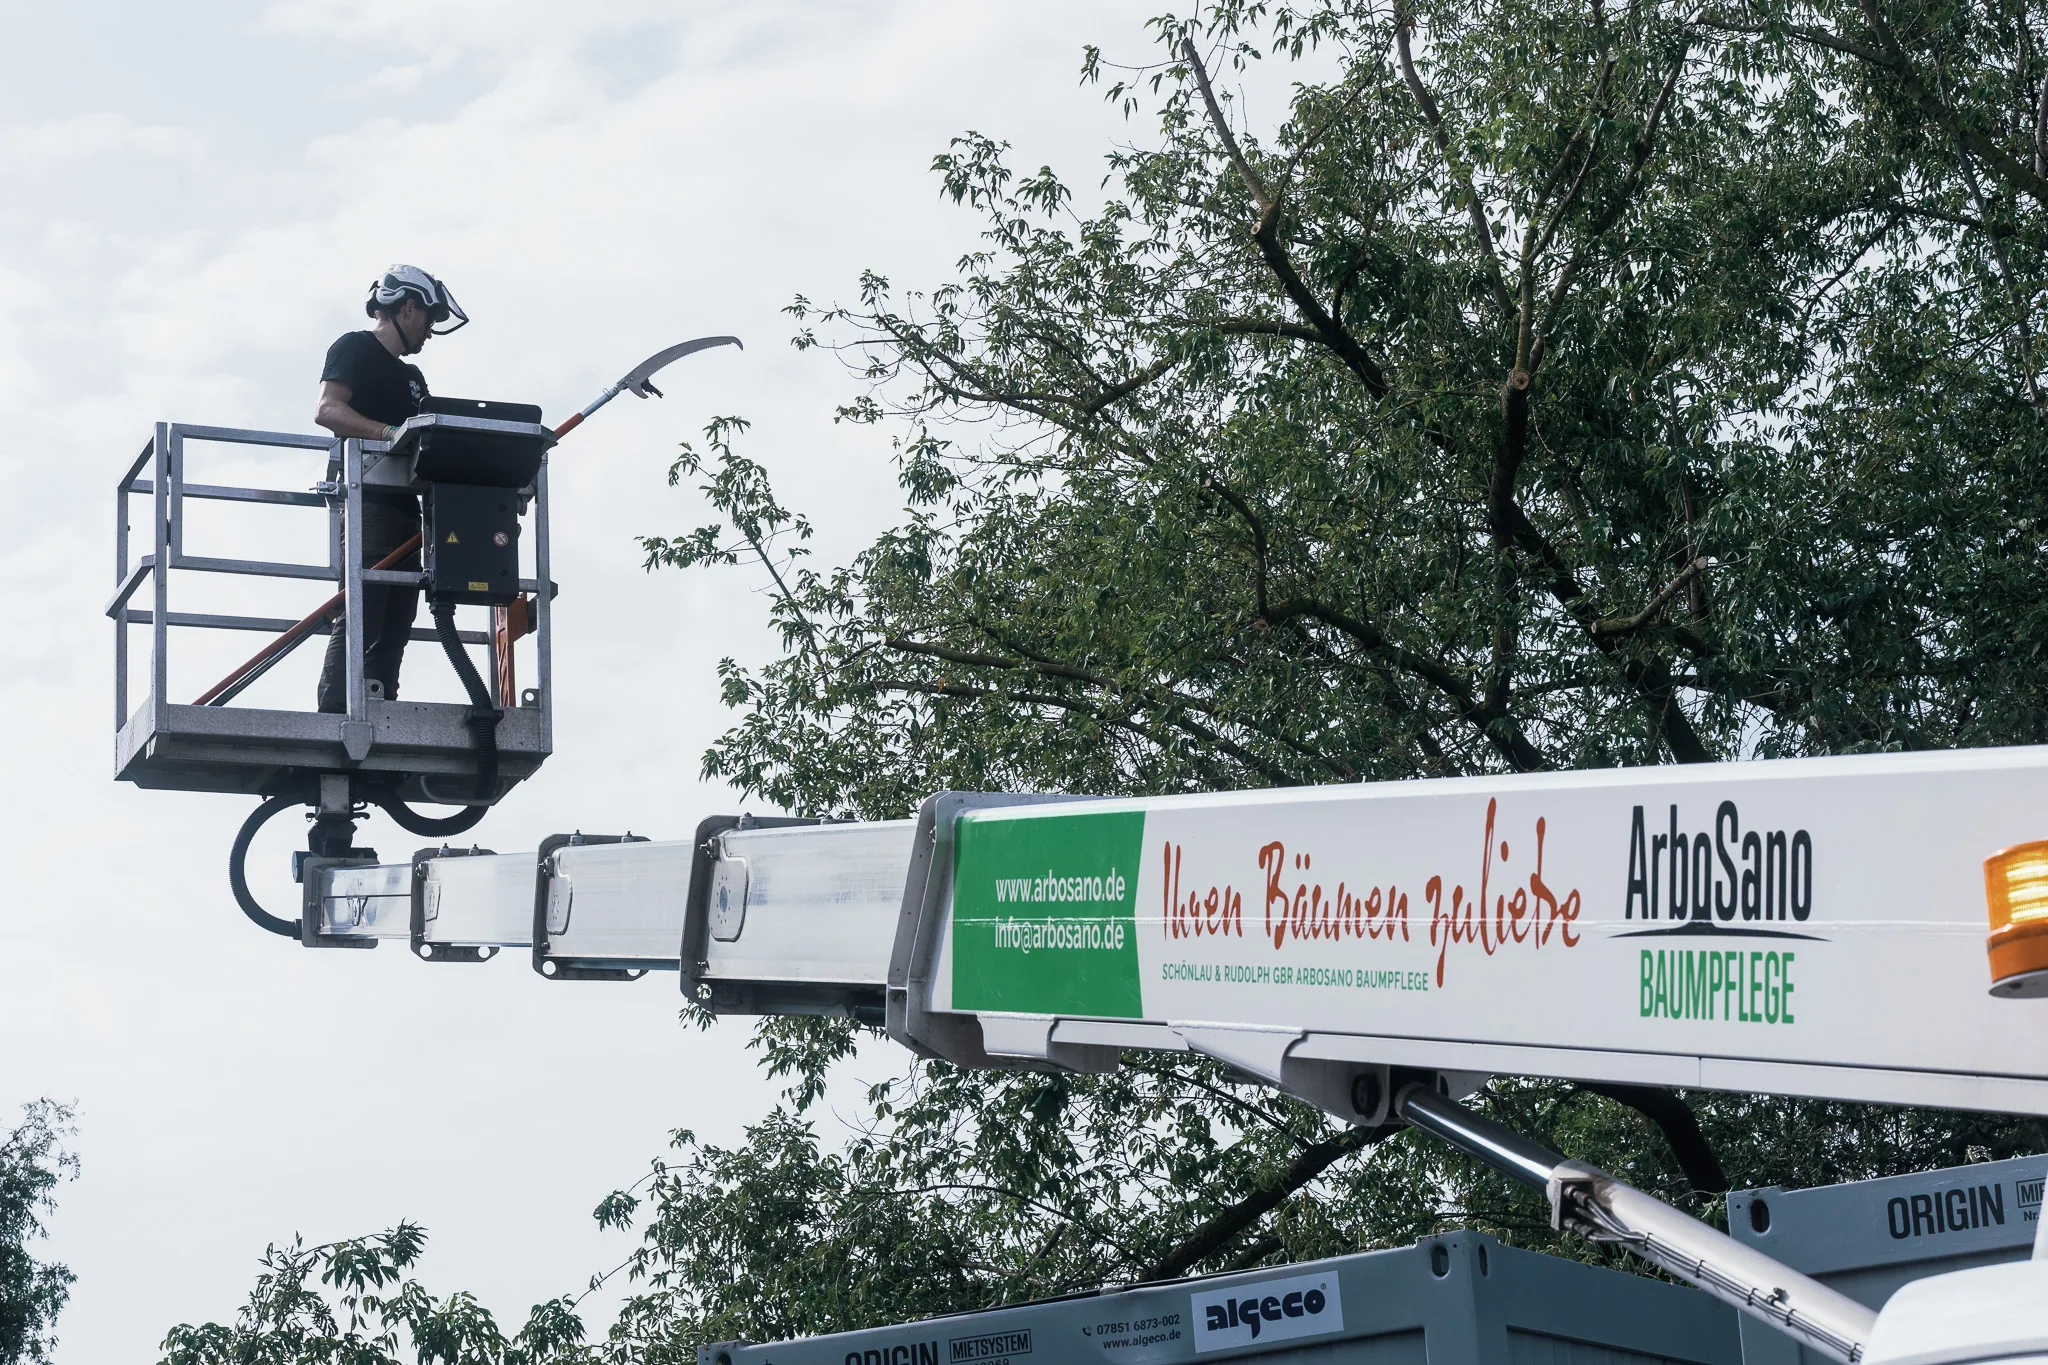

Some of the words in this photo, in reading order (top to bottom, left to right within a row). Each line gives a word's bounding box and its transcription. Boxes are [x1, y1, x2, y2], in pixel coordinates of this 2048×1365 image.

[1625, 800, 1812, 921] ArboSano
[995, 867, 1126, 902] www.arbosano.de
[1163, 841, 1242, 940] Ihren
[1258, 841, 1409, 950] Bäumen
[1425, 796, 1581, 988] zuliebe
[995, 915, 1125, 954] info@arbosano.de
[1162, 960, 1212, 982] SCHÖNLAU
[1215, 965, 1221, 982] &
[1224, 965, 1270, 984] RUDOLPH
[1273, 967, 1293, 985] GBR
[1295, 967, 1352, 987] ARBOSANO
[1356, 969, 1429, 991] BAUMPFLEGE
[1640, 949, 1795, 1025] BAUMPFLEGE
[1887, 1183, 2005, 1239] ORIGIN
[1097, 1322, 1130, 1335] 07851
[1133, 1314, 1180, 1331] 6873-002
[1206, 1289, 1326, 1339] algeco
[952, 1333, 1029, 1359] MIETSYSTEM
[1103, 1329, 1181, 1349] www.algeco.de
